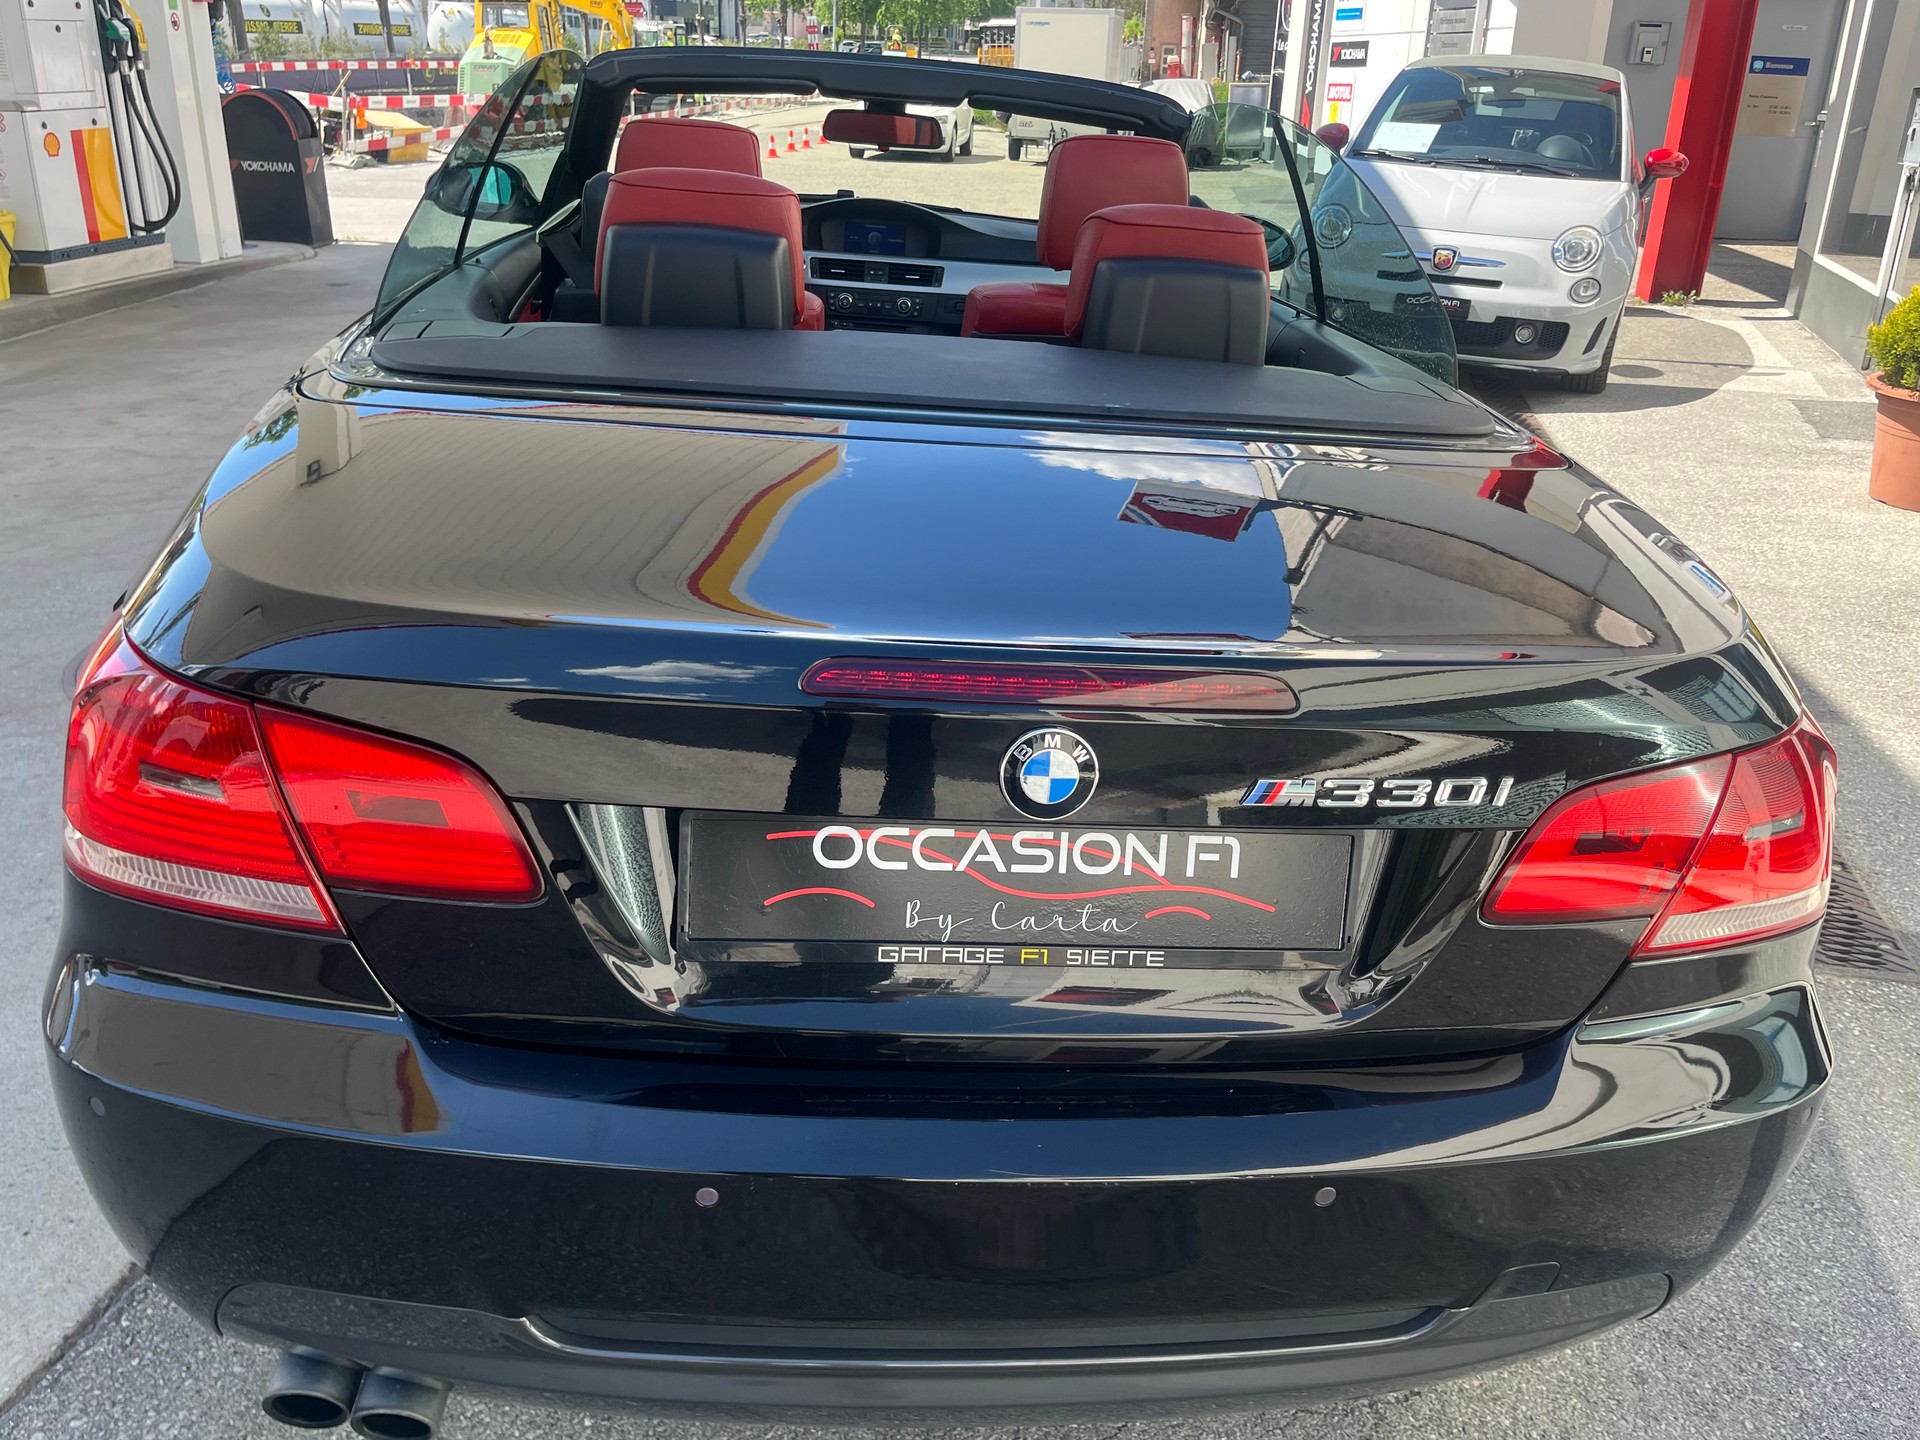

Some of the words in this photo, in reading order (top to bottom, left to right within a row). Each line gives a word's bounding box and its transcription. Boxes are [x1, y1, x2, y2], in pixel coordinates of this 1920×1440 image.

[1341, 48, 1366, 60] YOKOHAMA
[1327, 86, 1351, 100] MOTUL
[240, 160, 296, 173] YOKOHAMA
[1406, 295, 1451, 306] OCCAON
[1013, 733, 1090, 764] BMW
[812, 825, 1168, 877] OCCASION
[1186, 835, 1241, 878] F1
[905, 899, 974, 943] By
[991, 901, 1138, 933] Carta
[877, 946, 1005, 964] GARAGE
[1021, 948, 1049, 965] F1
[1066, 949, 1165, 967] SIERRE
